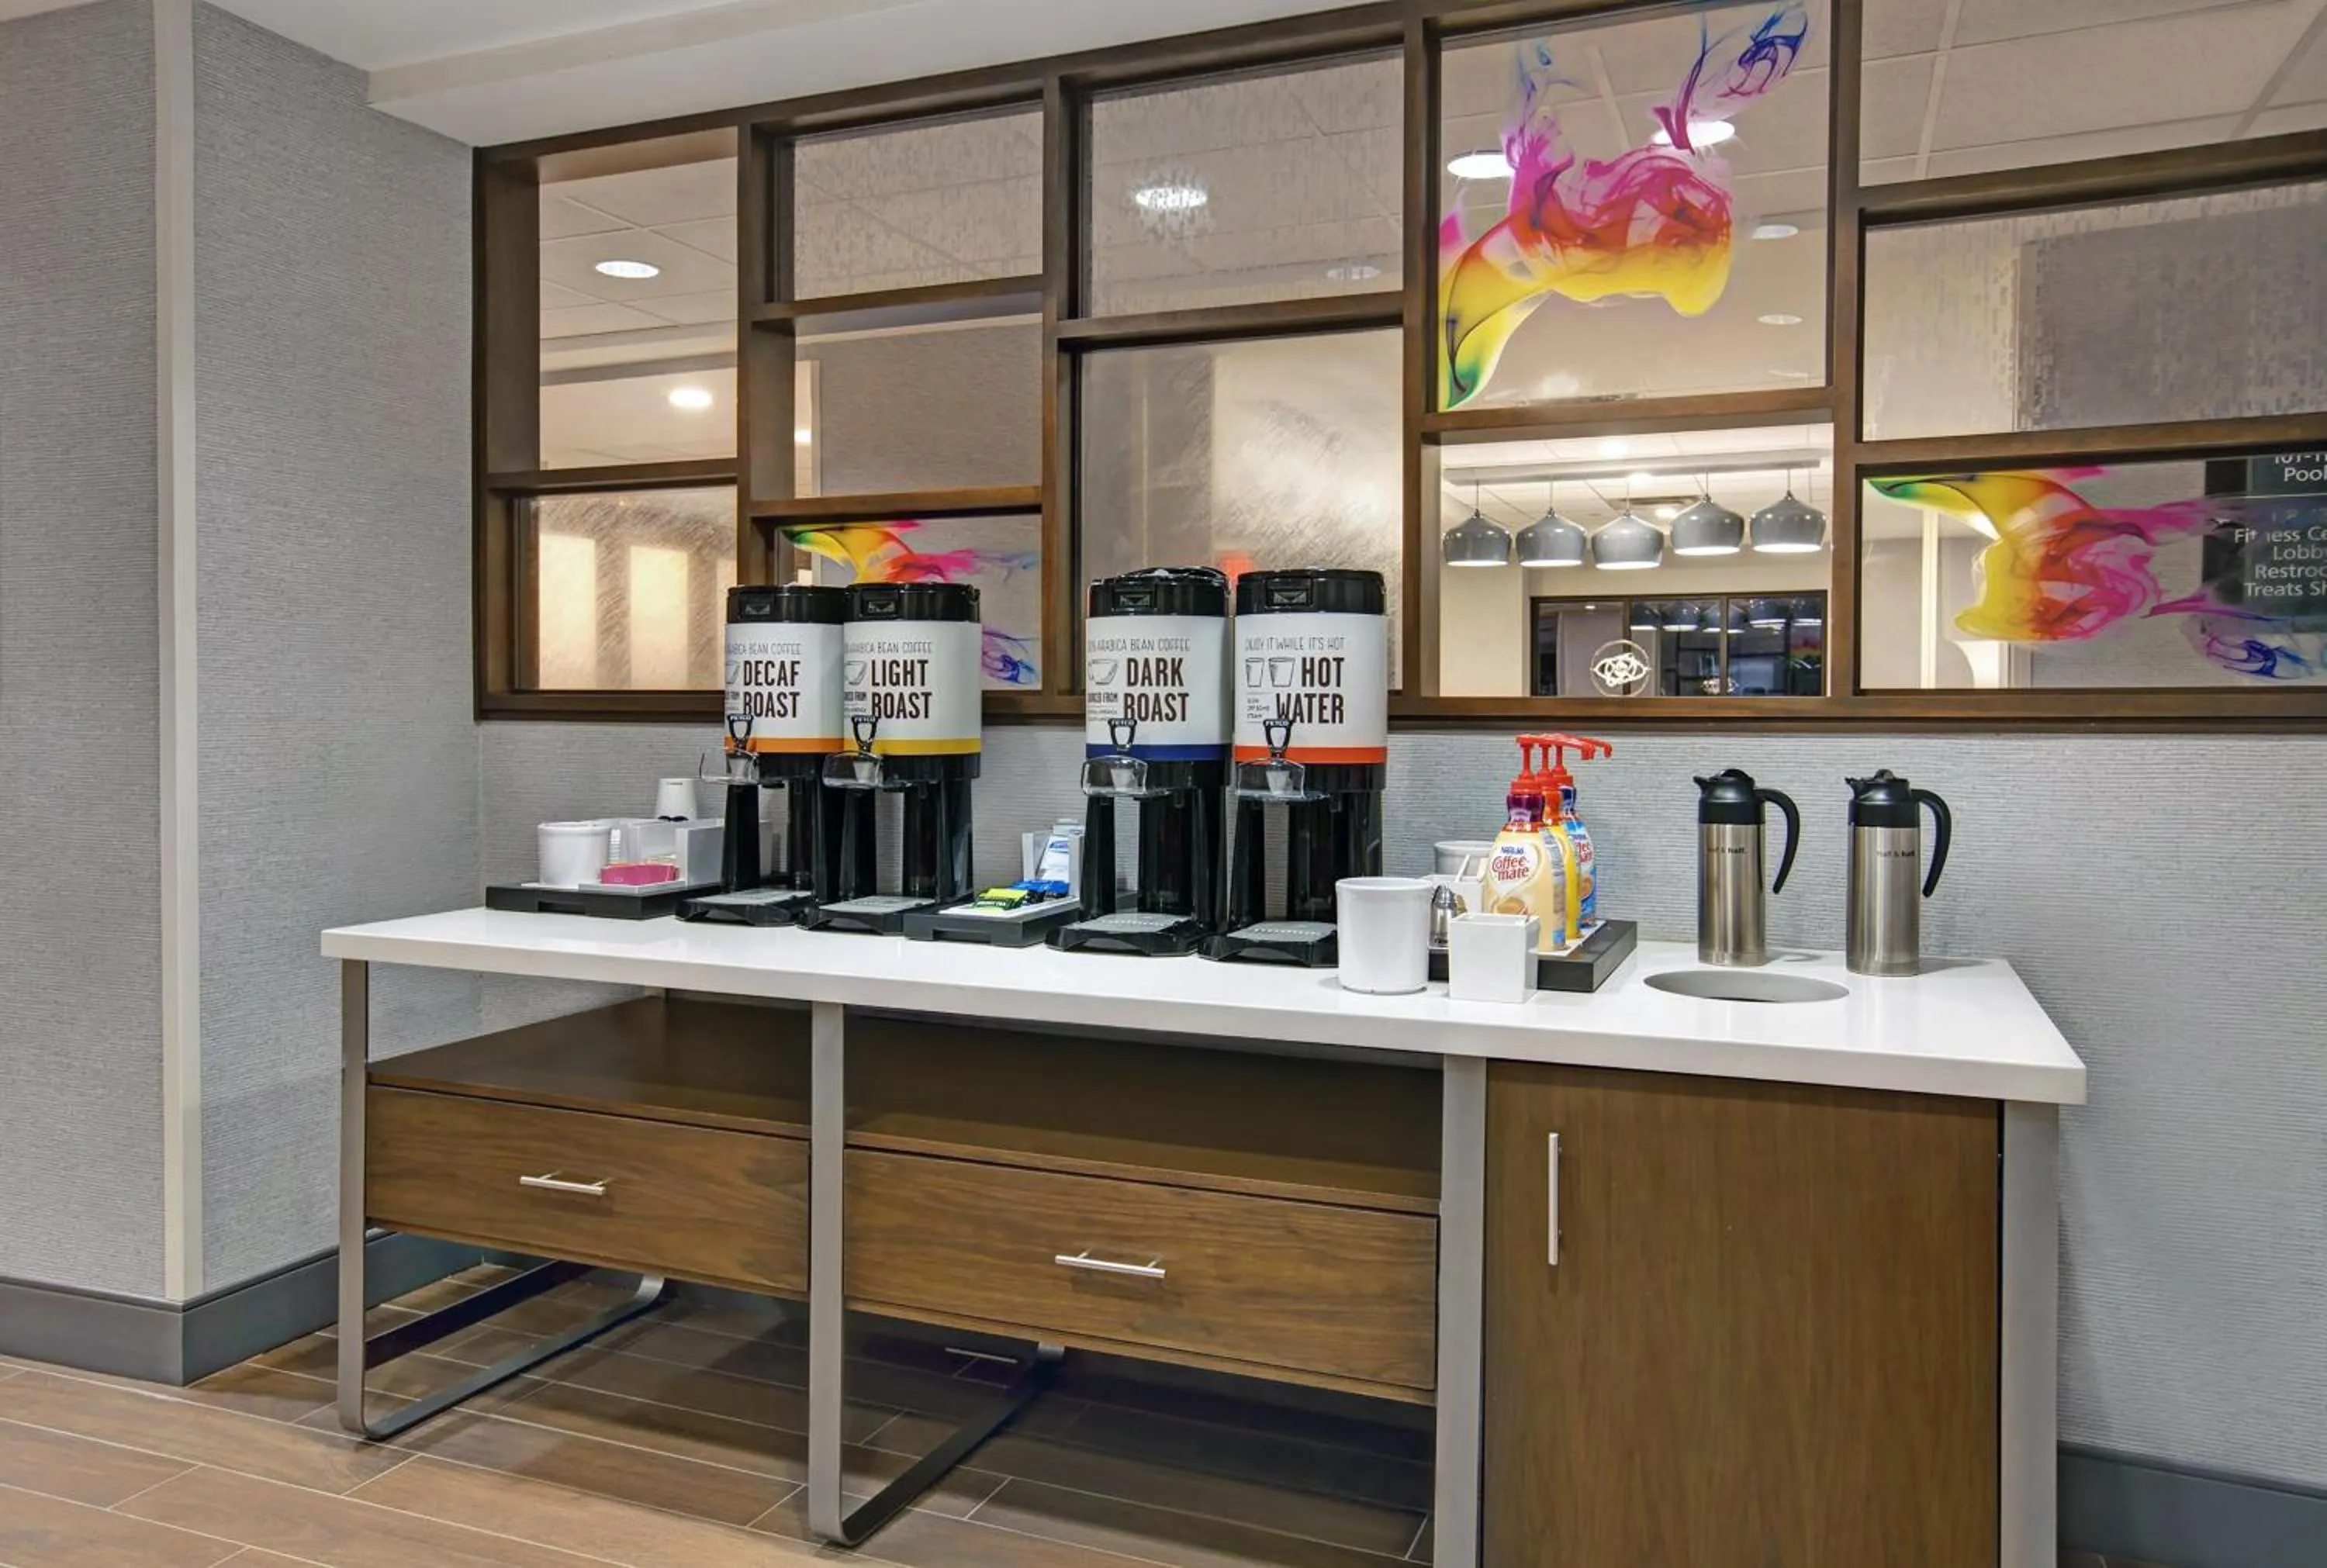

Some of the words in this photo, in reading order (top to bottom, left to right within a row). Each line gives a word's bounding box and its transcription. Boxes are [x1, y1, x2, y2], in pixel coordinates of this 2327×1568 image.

[2284, 466, 2327, 482] Pool
[2243, 582, 2303, 596] Treats
[770, 643, 801, 655] COFFEE
[902, 641, 932, 654] COFFEE
[1130, 638, 1155, 651] BEAN
[1158, 637, 1191, 652] COFFEE
[1327, 636, 1347, 651] HOT
[743, 660, 800, 686] DECAF
[871, 659, 928, 686] LIGHT
[1127, 657, 1184, 687] DARK
[1302, 656, 1344, 688] HOT
[743, 692, 800, 718] ROAST
[871, 692, 932, 719] ROAST
[1124, 692, 1190, 722] ROAST
[1276, 692, 1344, 724] WATER
